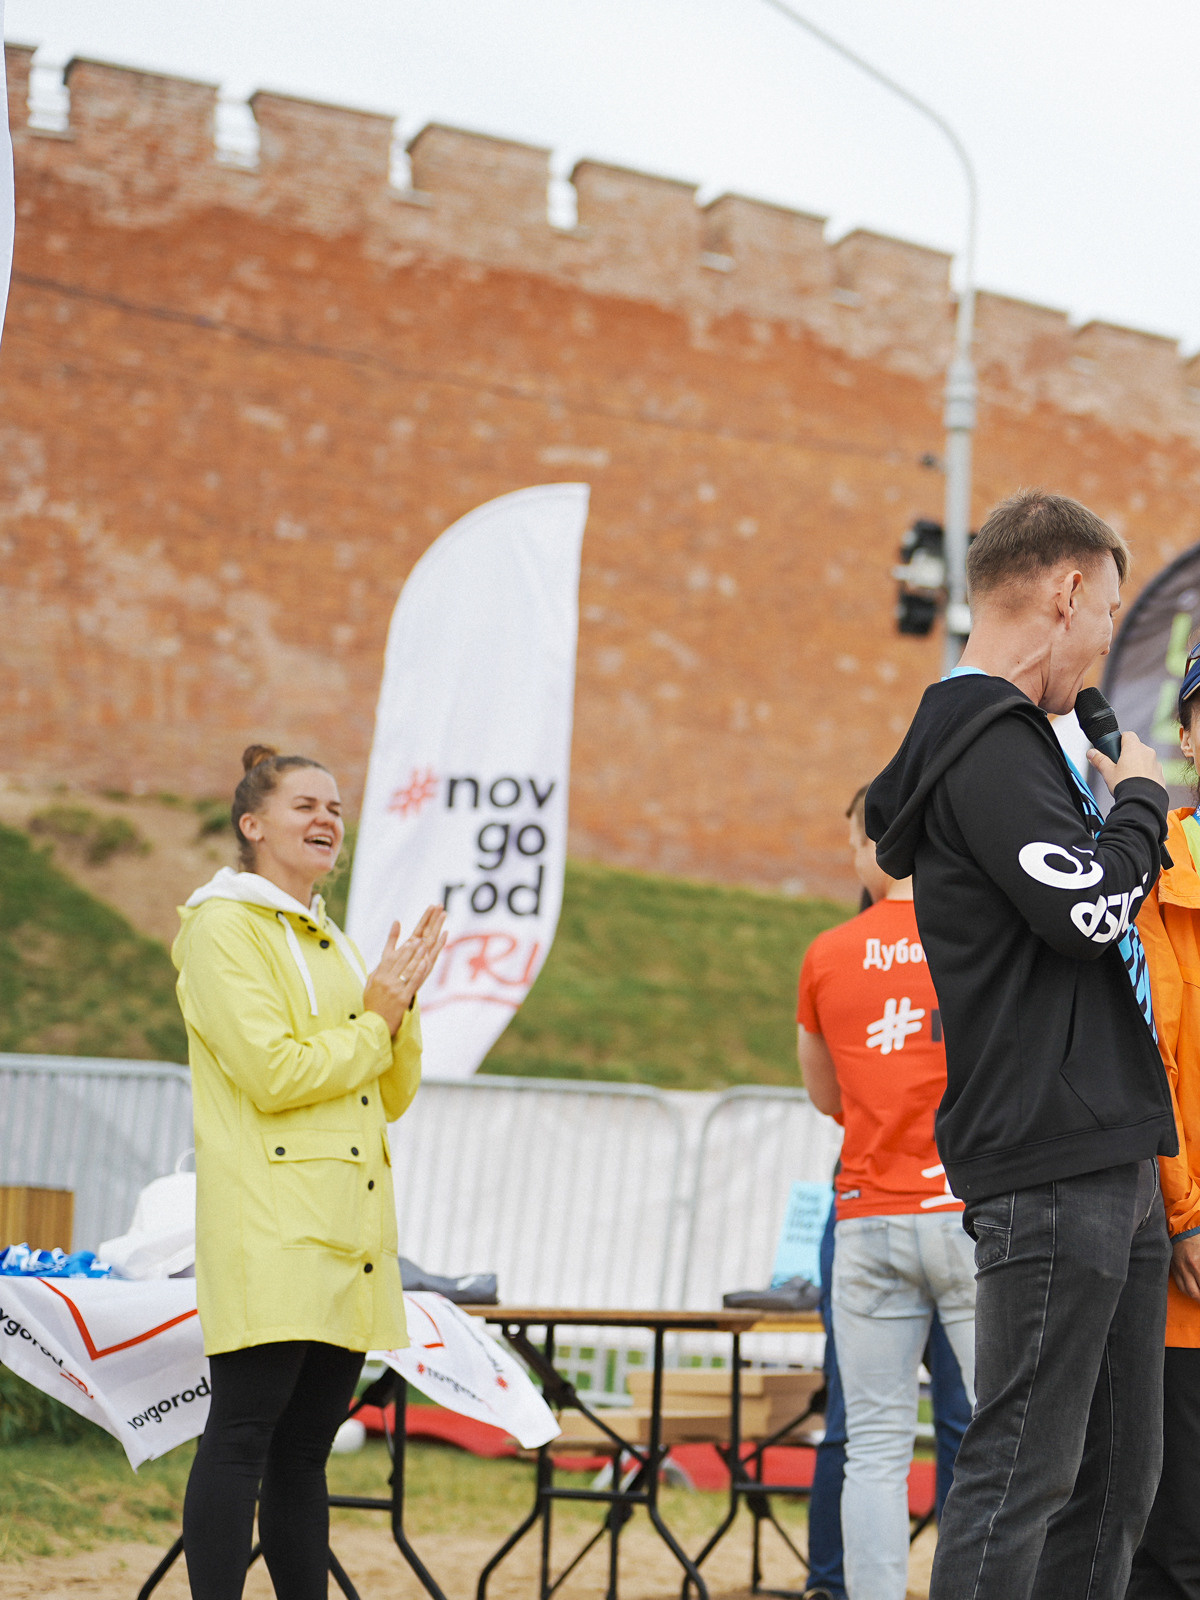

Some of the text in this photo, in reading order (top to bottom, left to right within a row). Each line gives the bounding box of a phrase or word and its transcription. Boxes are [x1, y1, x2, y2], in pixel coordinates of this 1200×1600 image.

[387, 764, 555, 818] #nov
[477, 823, 546, 870] go
[442, 865, 545, 917] rod
[1070, 872, 1149, 943] asic
[863, 937, 927, 972] Дубо
